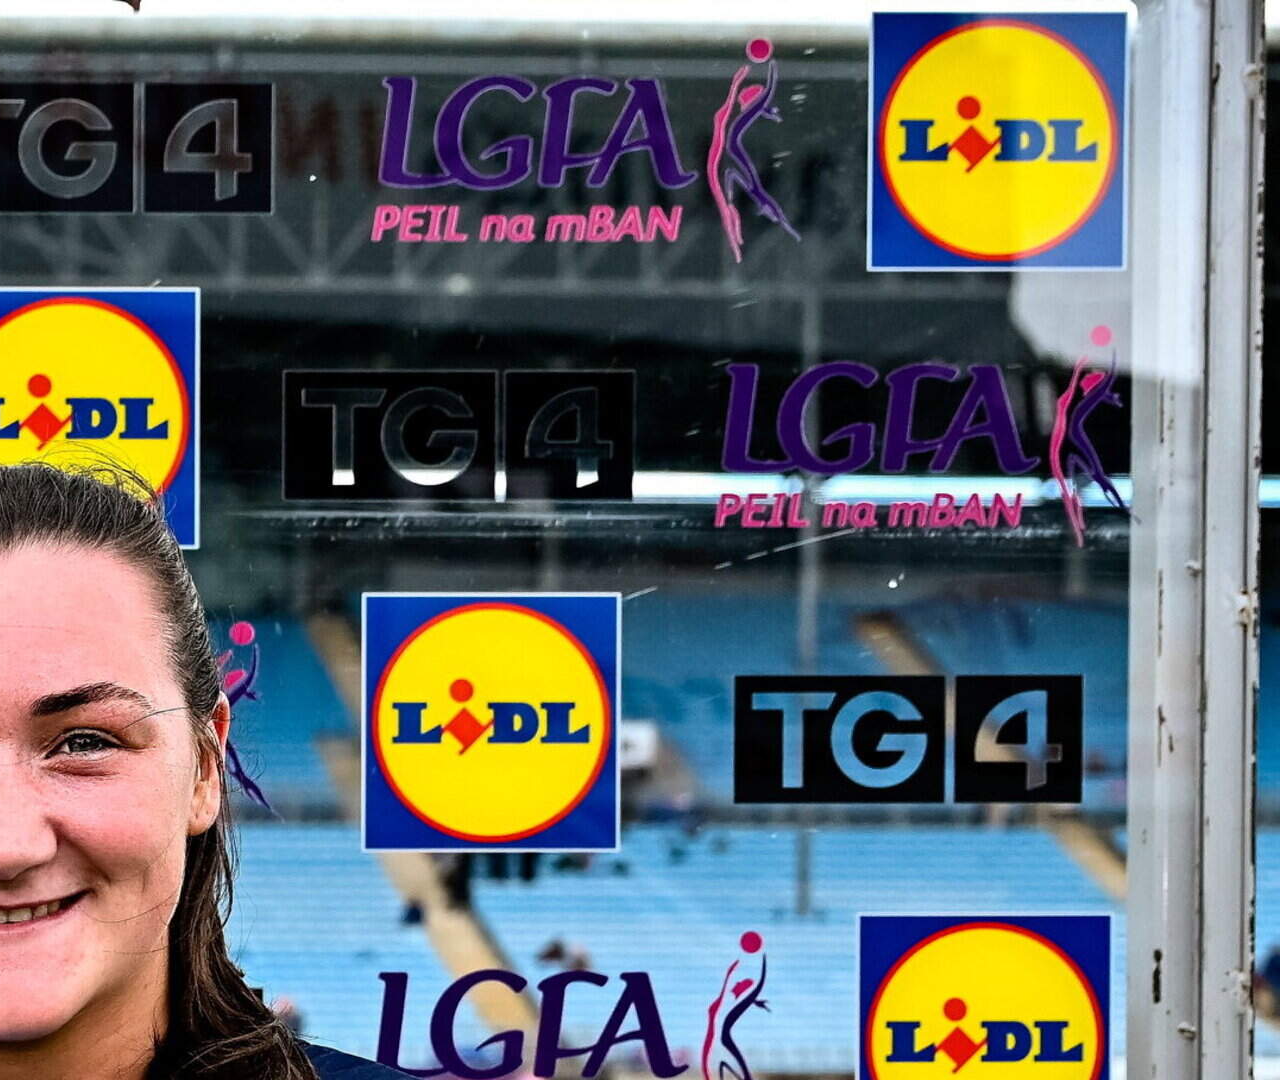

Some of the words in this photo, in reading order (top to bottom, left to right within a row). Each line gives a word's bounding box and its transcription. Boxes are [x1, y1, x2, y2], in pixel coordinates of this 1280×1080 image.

[377, 76, 696, 189] LGFA
[371, 205, 468, 242] PEIL
[479, 213, 534, 241] na
[546, 205, 682, 242] mBAN
[720, 362, 1040, 474] LGFA
[714, 494, 812, 529] PEIL
[822, 501, 876, 529] na
[887, 493, 1022, 529] mBAN
[375, 969, 689, 1080] LGFA
